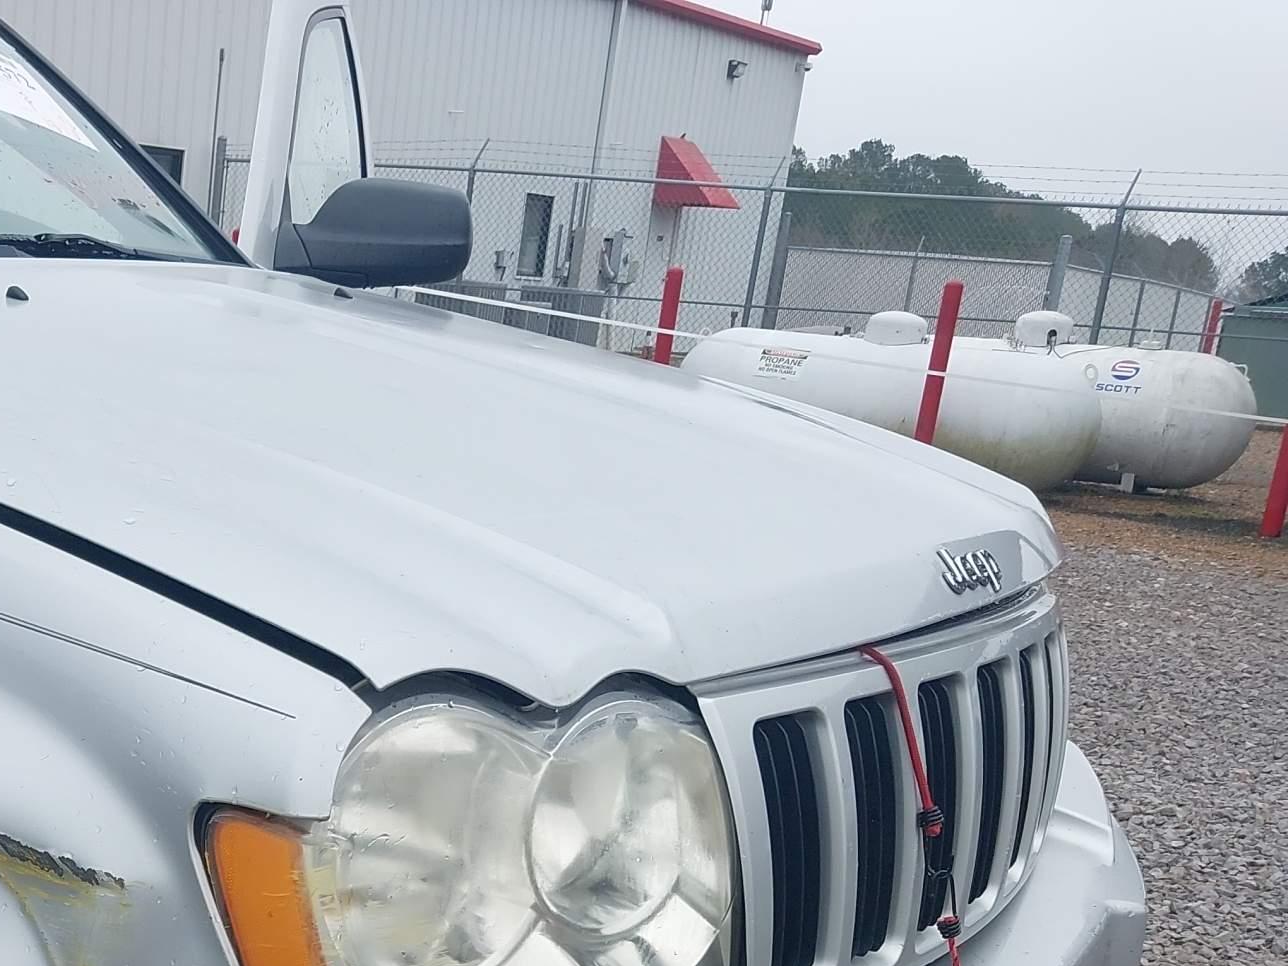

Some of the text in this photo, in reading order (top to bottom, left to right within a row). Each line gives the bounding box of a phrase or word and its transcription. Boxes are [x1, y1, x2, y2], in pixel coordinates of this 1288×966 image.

[759, 355, 804, 367] PROPANE
[1095, 383, 1142, 394] SCOTT
[936, 549, 1002, 595] Jeep
